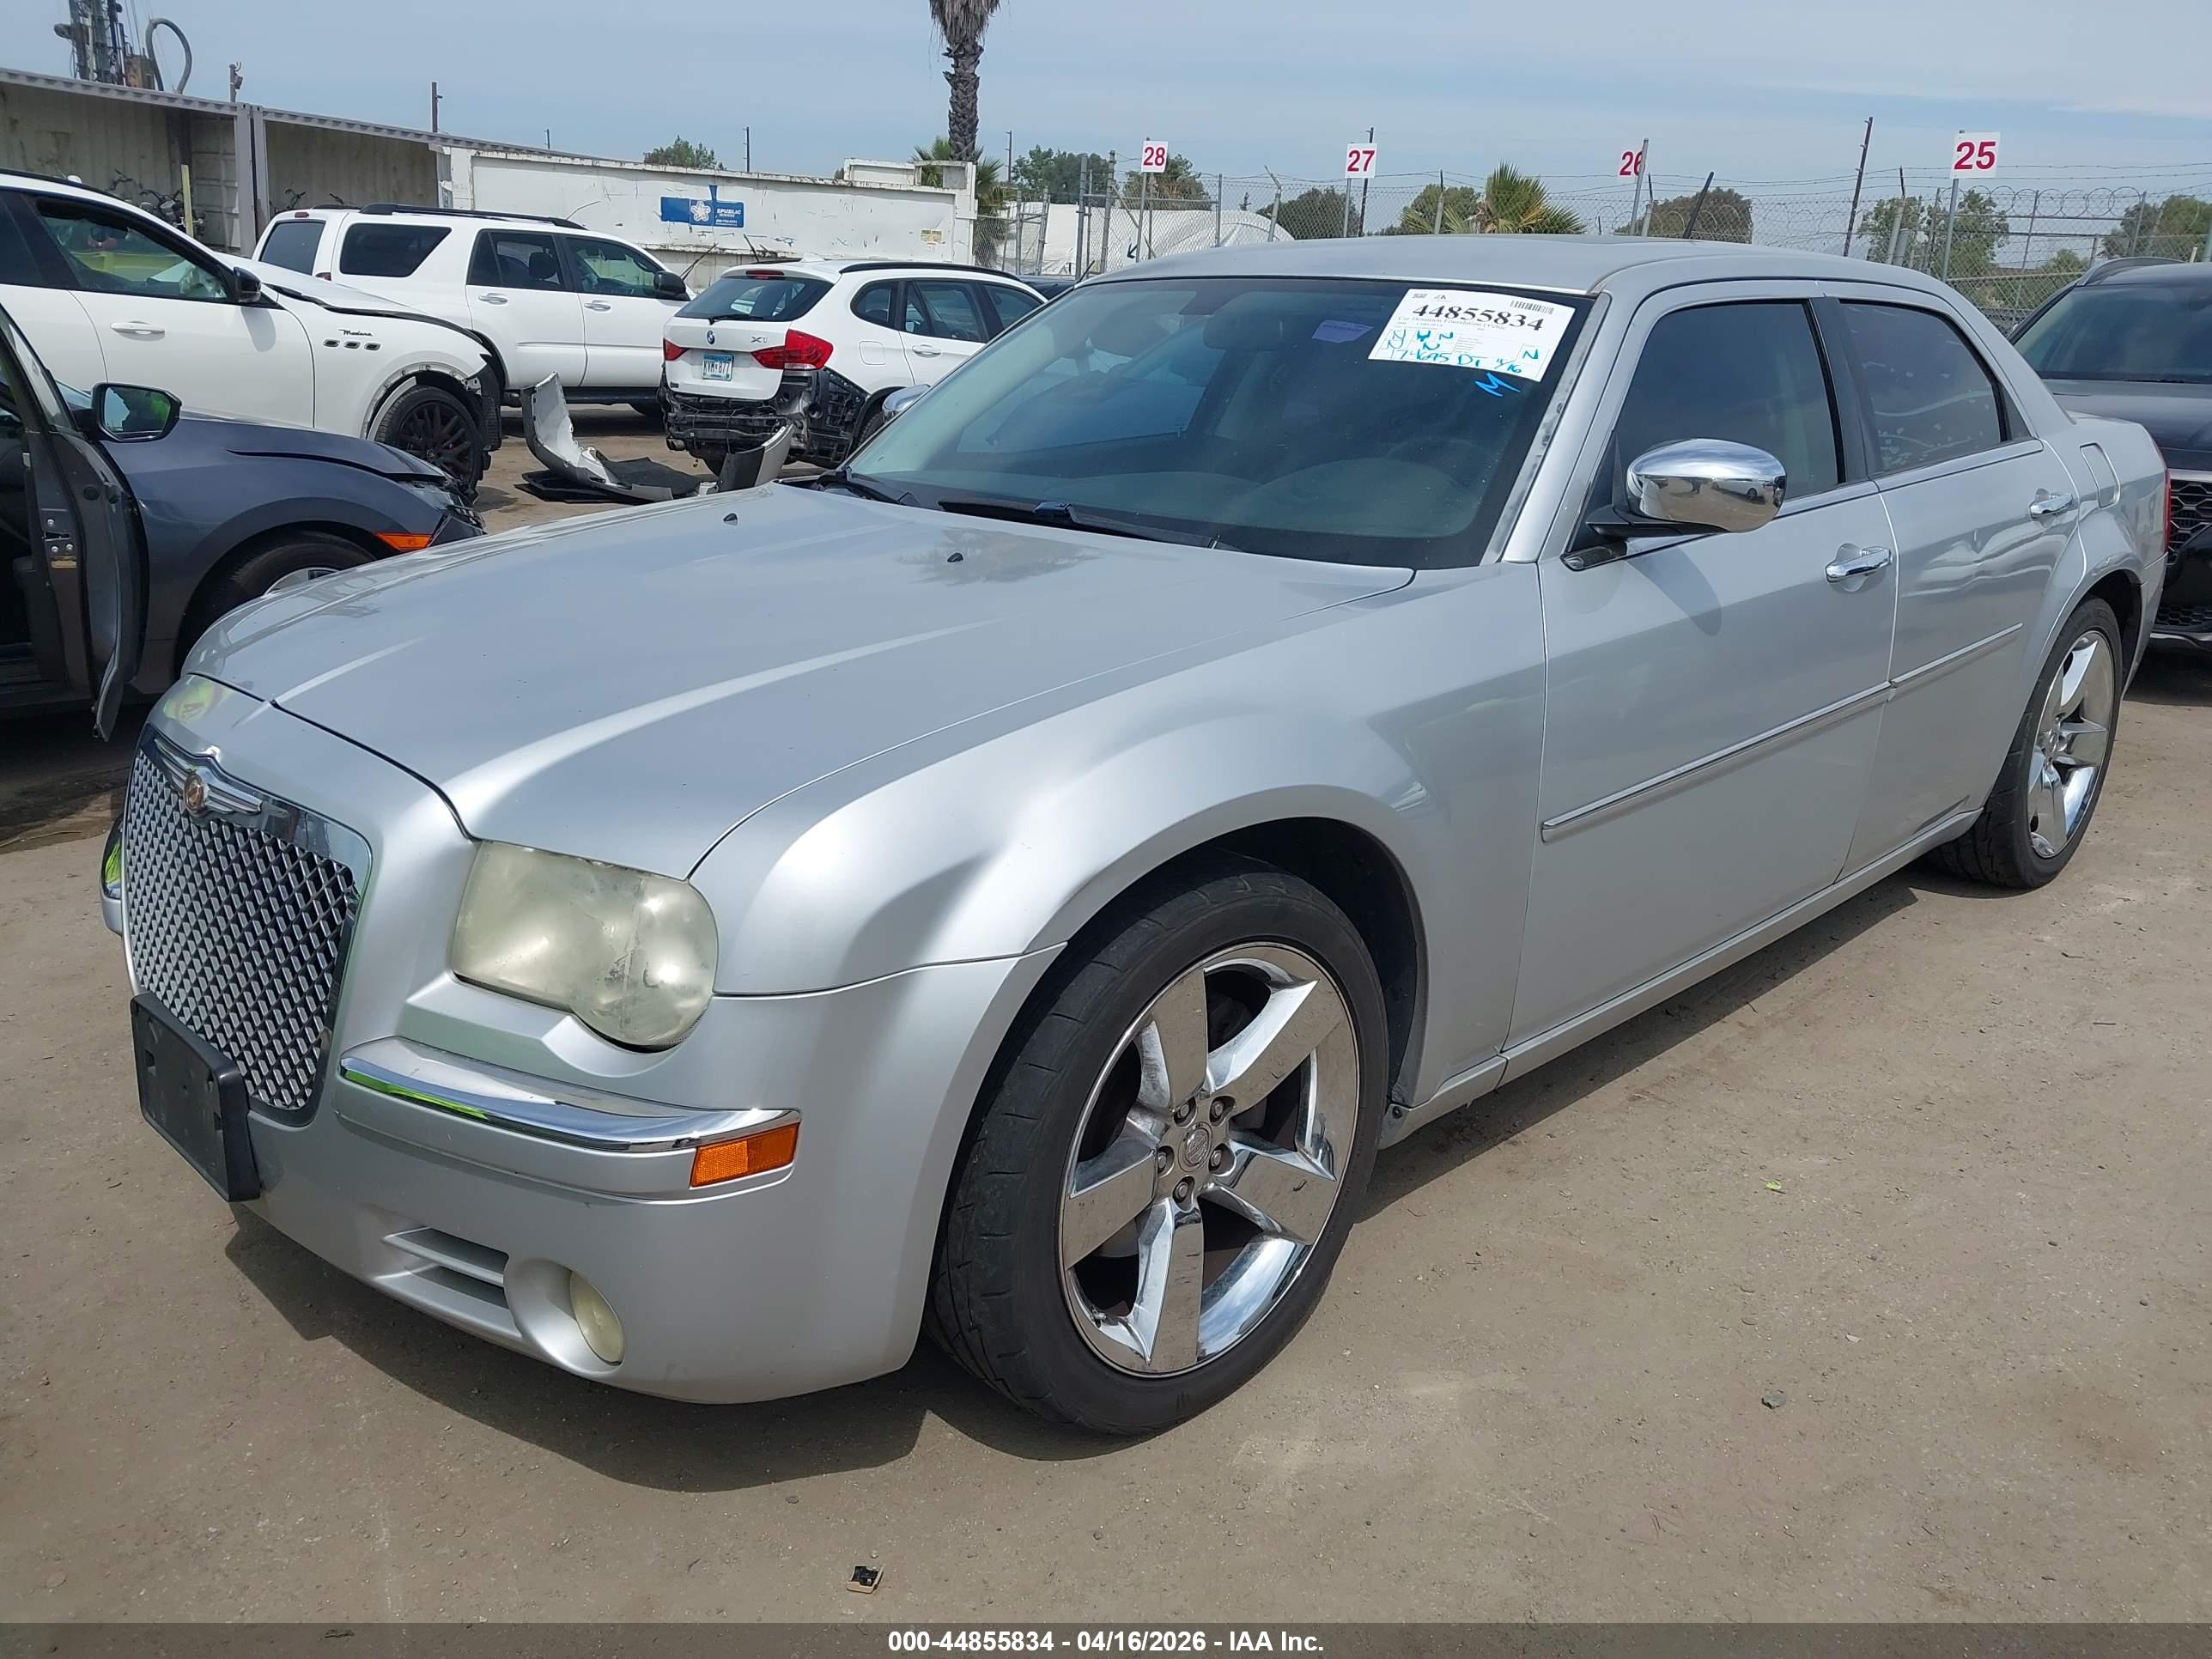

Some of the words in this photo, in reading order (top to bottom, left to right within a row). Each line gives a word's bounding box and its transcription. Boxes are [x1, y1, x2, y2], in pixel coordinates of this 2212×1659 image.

[1143, 146, 1165, 167] 28
[1346, 149, 1376, 172] 27
[1954, 141, 1996, 170] 25
[1413, 304, 1545, 331] 44855834
